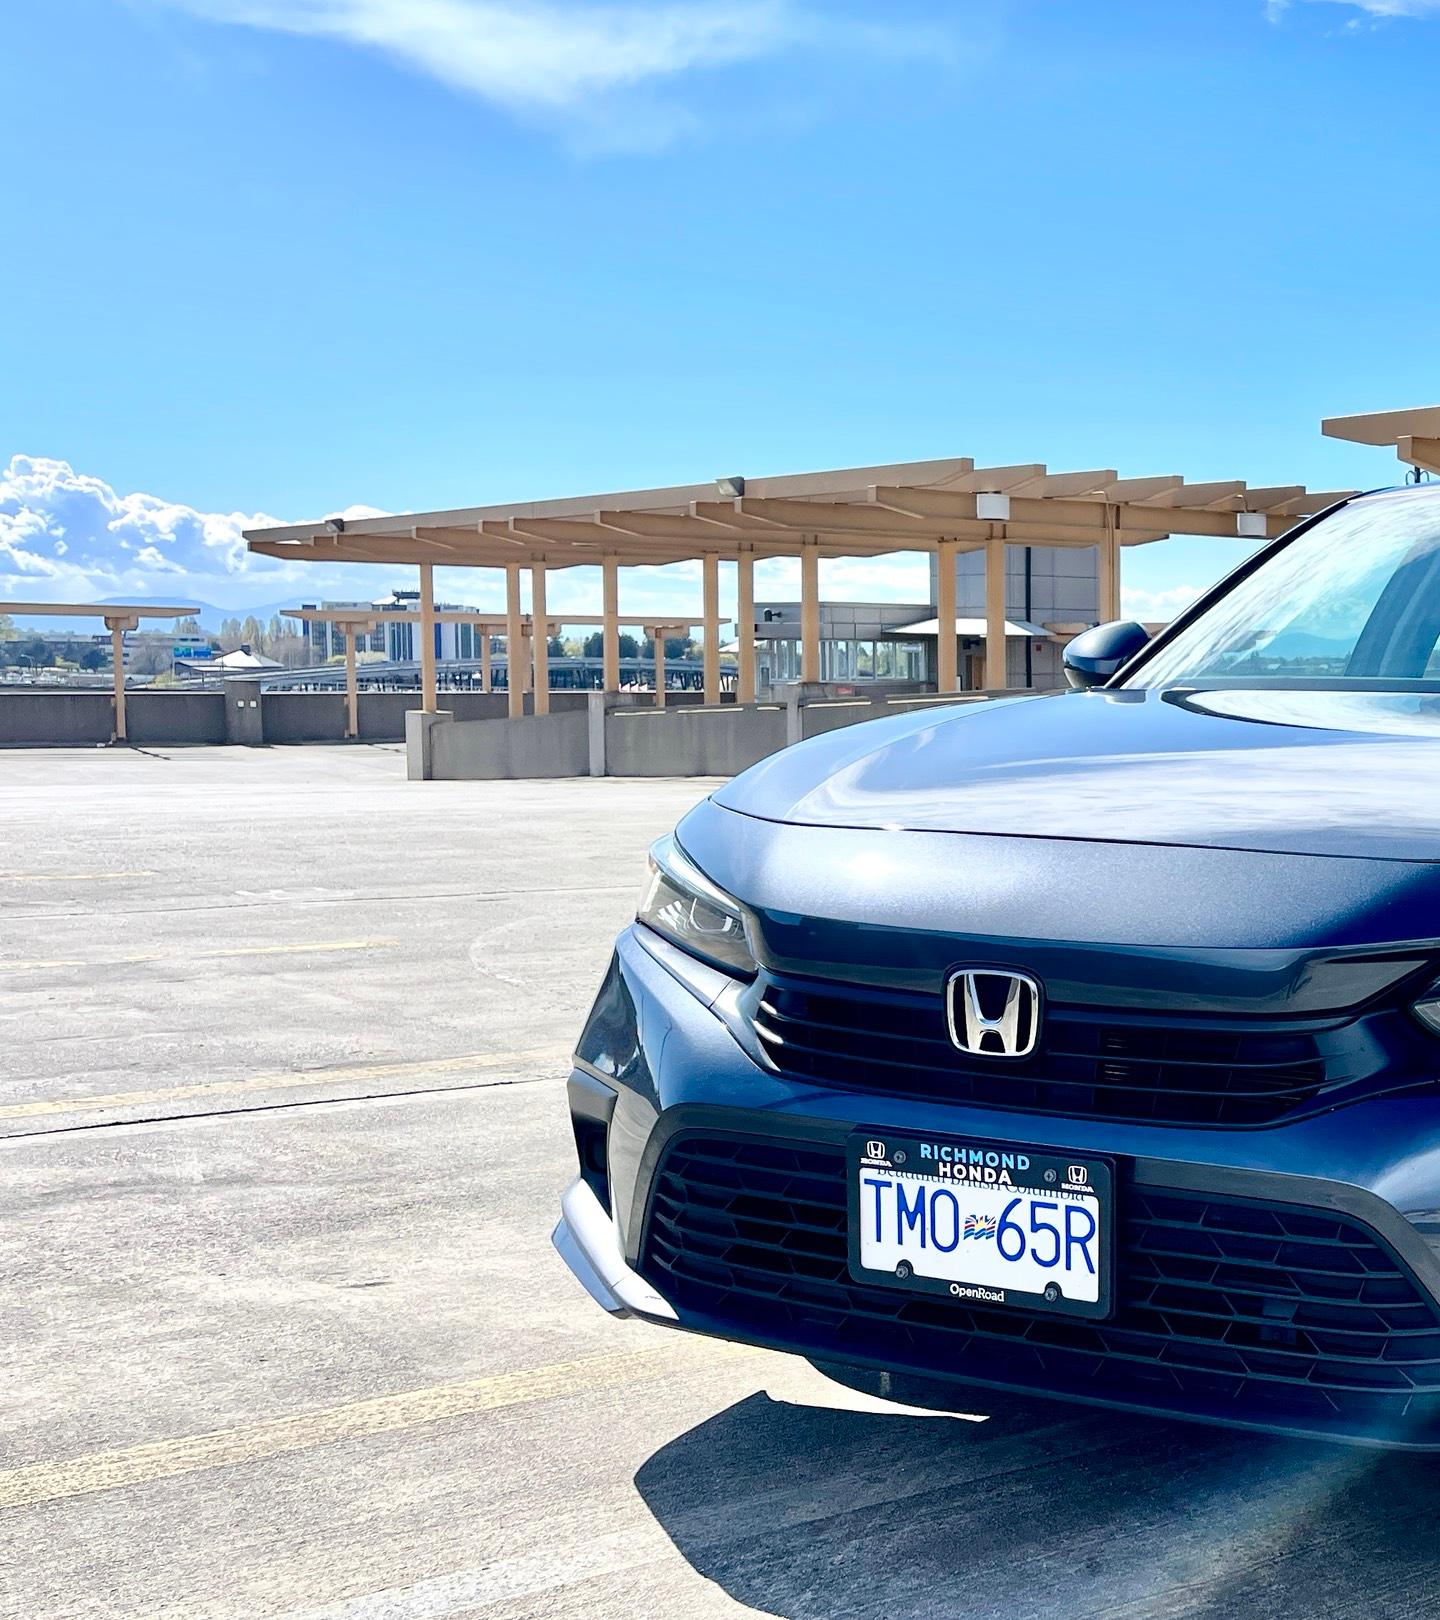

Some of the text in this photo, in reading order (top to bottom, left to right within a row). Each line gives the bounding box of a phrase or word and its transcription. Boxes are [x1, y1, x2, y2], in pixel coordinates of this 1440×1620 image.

[920, 1143, 1030, 1170] RICHMOND
[938, 1161, 1013, 1185] HONDA
[997, 1198, 1096, 1274] 65R
[949, 1283, 1005, 1302] OpenRoad
